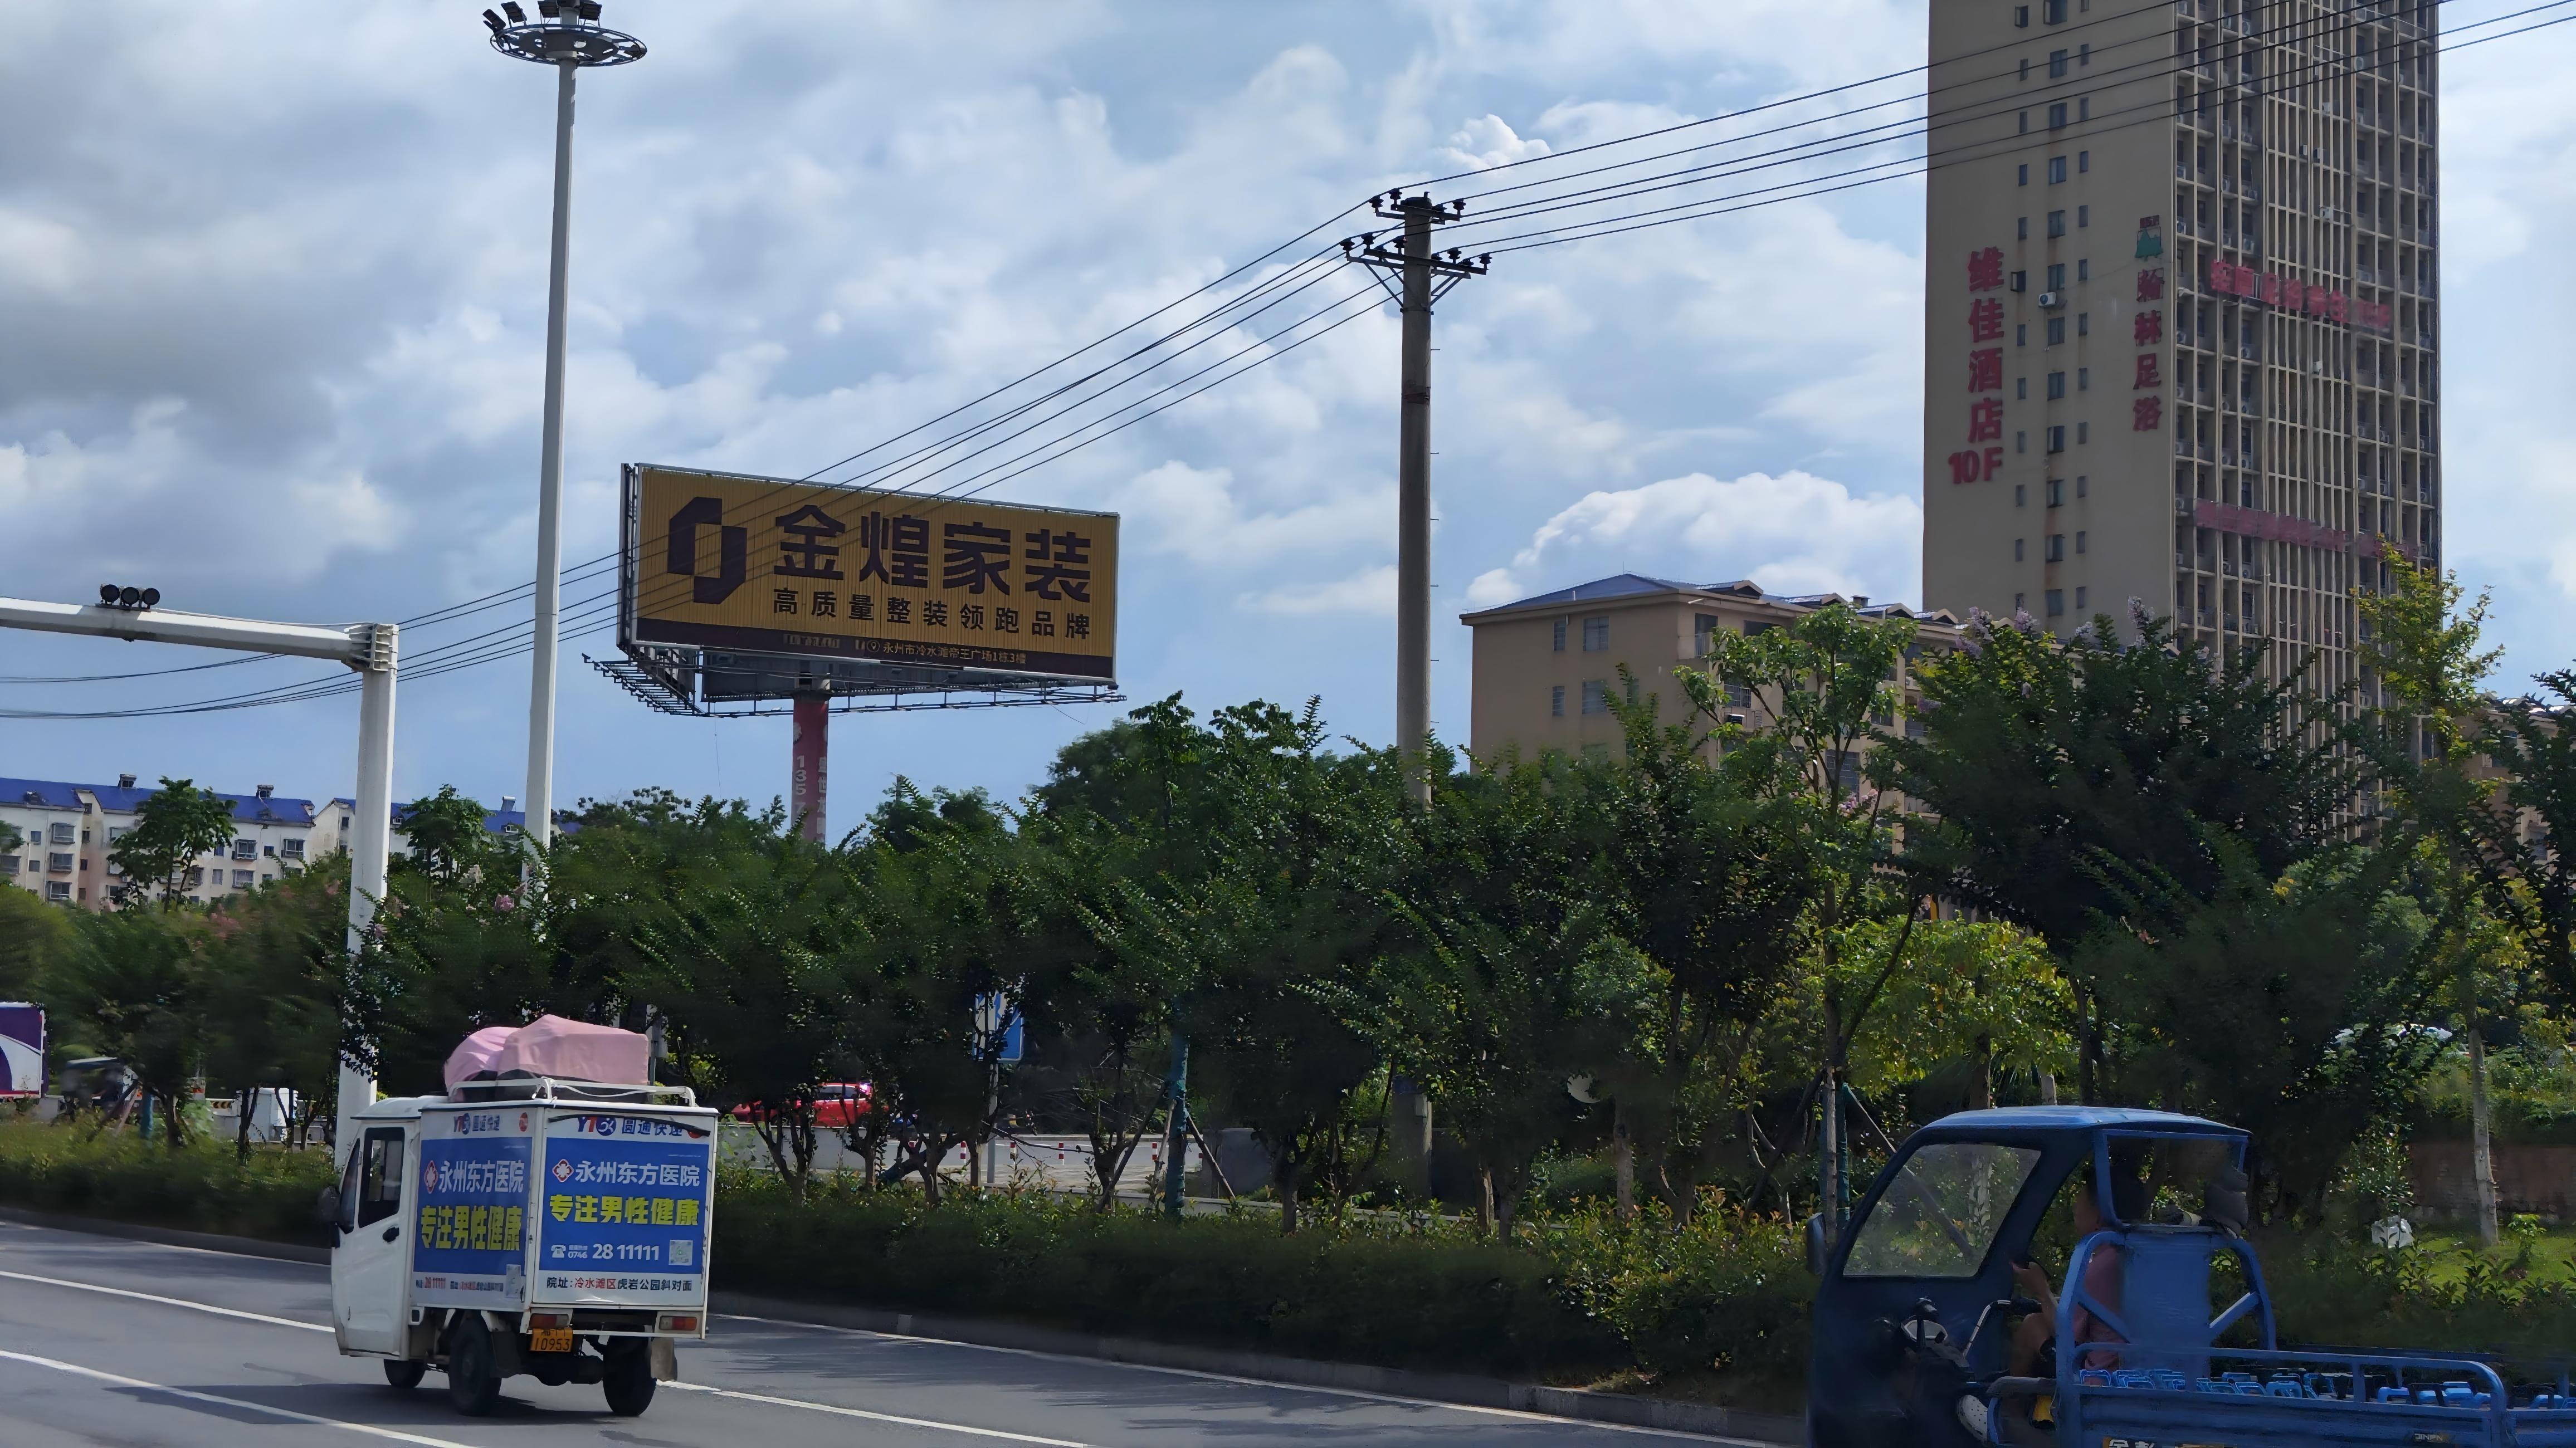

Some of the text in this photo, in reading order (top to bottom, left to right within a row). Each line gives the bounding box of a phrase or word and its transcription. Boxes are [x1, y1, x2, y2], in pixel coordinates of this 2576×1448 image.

[1967, 246, 2004, 443] 维佳酒店
[1948, 447, 2004, 485] 10F
[774, 504, 1091, 603] 金煌家装
[773, 587, 1090, 640] 高质量整装领跑品牌
[438, 1160, 524, 1194] 永州东方医院
[574, 1160, 700, 1187] 永州东方医院
[421, 1205, 522, 1251] 专注男性健康
[549, 1194, 700, 1226] 专注男性健康
[592, 1243, 613, 1259] 28
[617, 1244, 660, 1260] 11111
[535, 1338, 570, 1351] 10953
